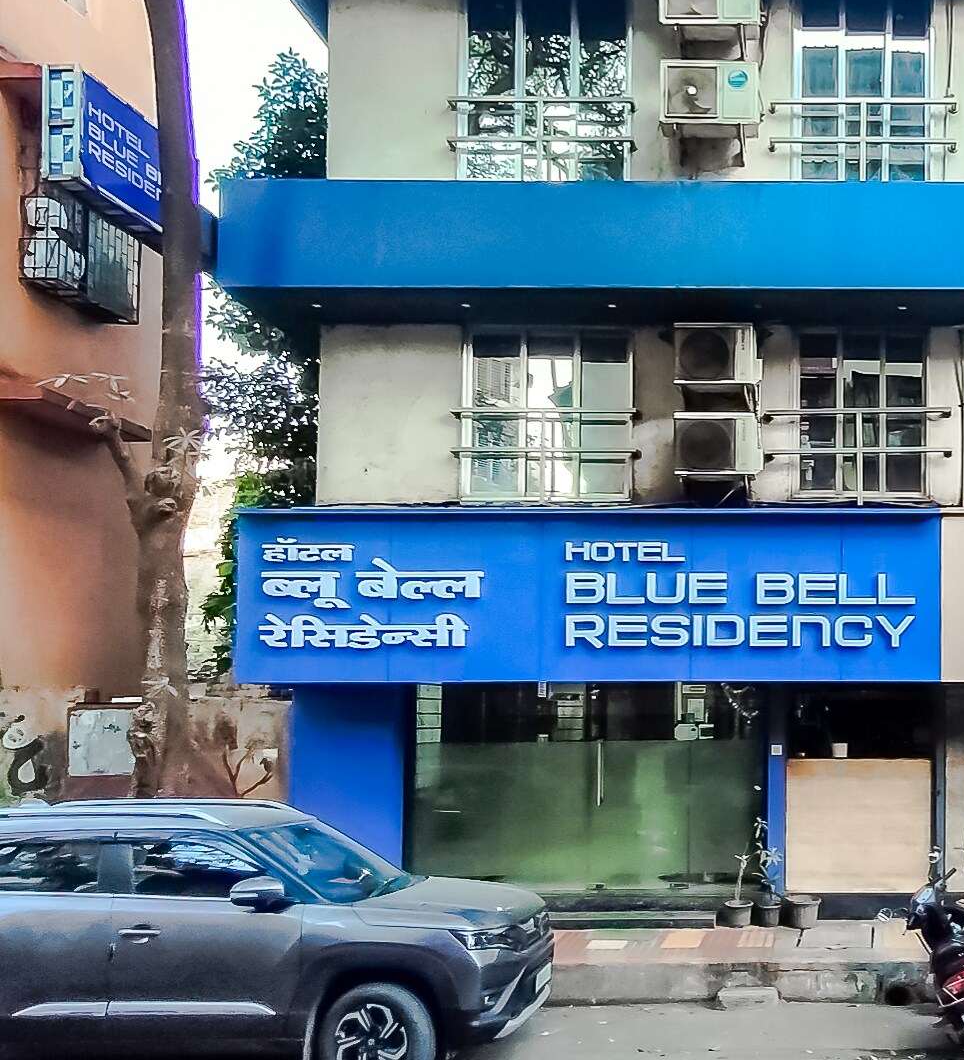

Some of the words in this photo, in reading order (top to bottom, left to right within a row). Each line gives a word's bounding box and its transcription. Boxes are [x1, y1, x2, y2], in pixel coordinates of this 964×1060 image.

[88, 101, 151, 159] HOTEL
[88, 121, 139, 169] BLUE
[145, 162, 162, 186] B
[261, 537, 355, 562] हॉटल
[565, 542, 687, 562] HOTEL
[261, 571, 351, 609] ब्लू
[355, 557, 485, 599] बेल्ल
[565, 572, 728, 605] BLUE
[756, 572, 916, 605] BELL
[258, 613, 470, 649] रेसिडेन्सी
[565, 614, 916, 648] RESIDENCY
